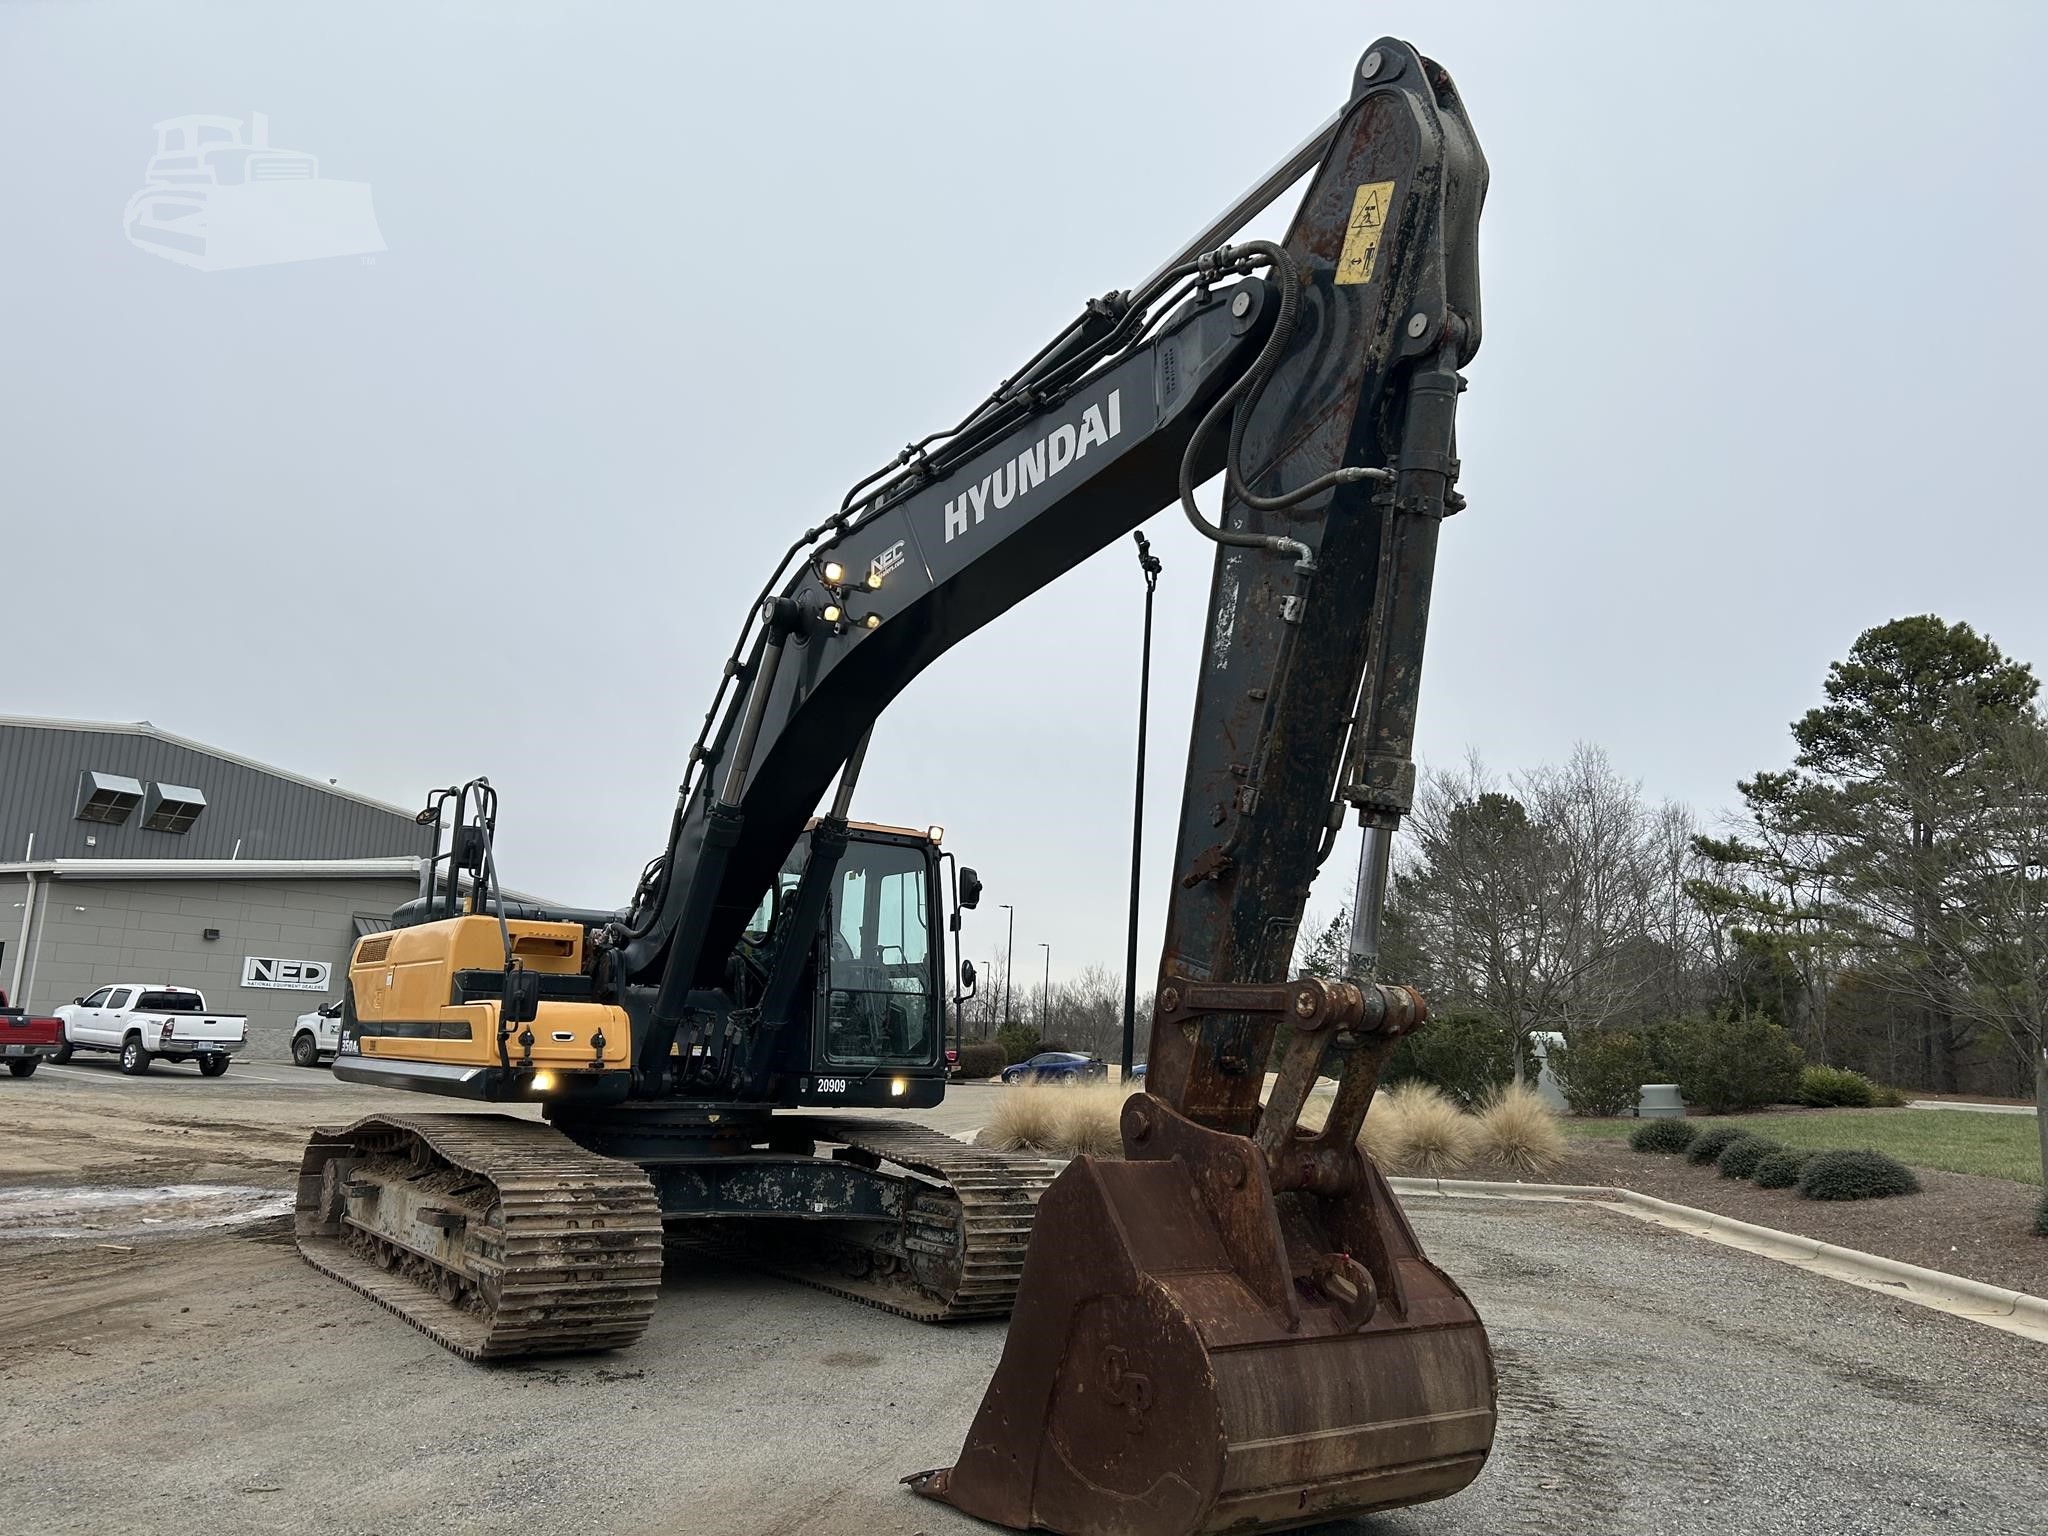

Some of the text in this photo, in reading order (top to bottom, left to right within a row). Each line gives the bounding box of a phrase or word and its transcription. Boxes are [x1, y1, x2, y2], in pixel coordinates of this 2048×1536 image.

[945, 388, 1121, 544] HYUNDAI
[248, 959, 327, 984] NED
[817, 1079, 846, 1093] 20909
